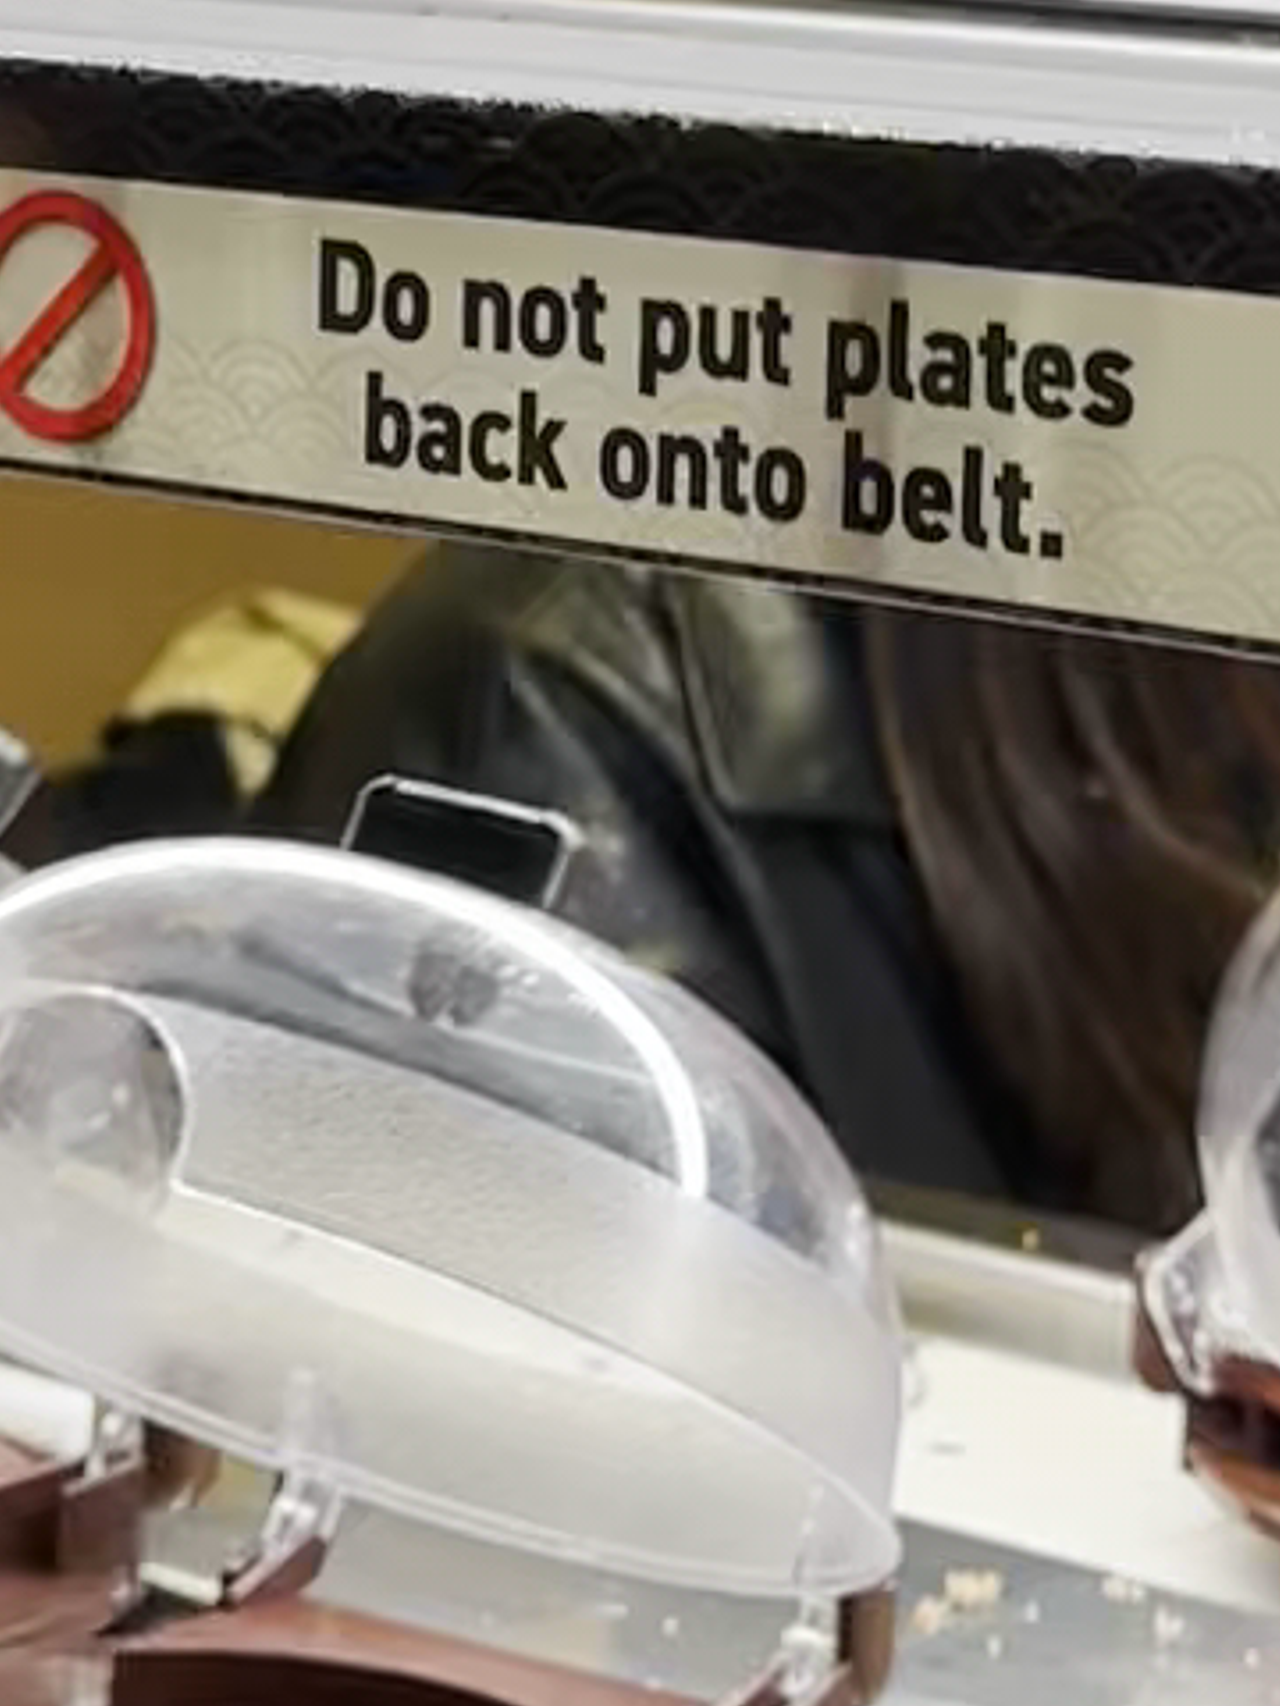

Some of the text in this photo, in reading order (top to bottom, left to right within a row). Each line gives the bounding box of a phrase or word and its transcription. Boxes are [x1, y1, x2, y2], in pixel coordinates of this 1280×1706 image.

[317, 236, 1137, 430] Do not put plates
[364, 370, 1065, 560] back onto belt.
